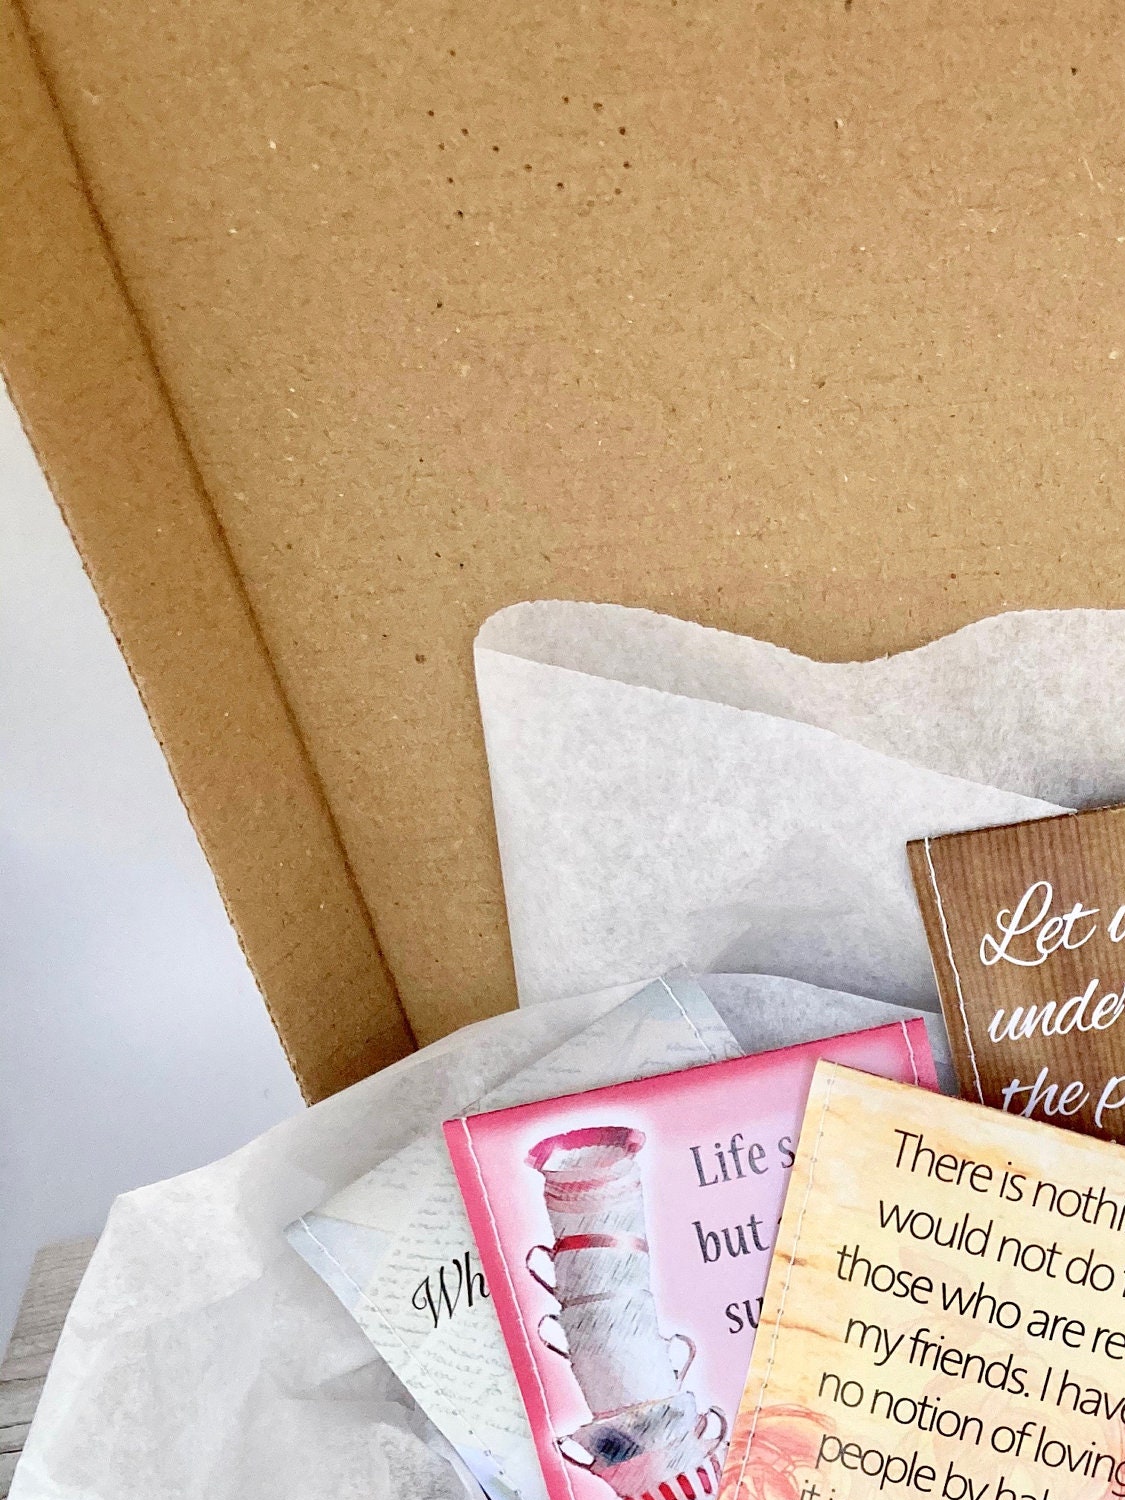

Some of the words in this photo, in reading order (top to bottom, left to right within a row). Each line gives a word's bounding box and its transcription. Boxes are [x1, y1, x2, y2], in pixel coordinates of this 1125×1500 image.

[979, 881, 1099, 967] Let
[1002, 1066, 1087, 1117] the
[690, 1133, 769, 1187] Life
[894, 1129, 994, 1193] There
[1001, 1162, 1025, 1202] is
[692, 1214, 770, 1263] but
[878, 1201, 992, 1257] would
[999, 1234, 1061, 1278] not
[1067, 1249, 1116, 1293] do
[836, 1245, 933, 1305] those
[940, 1281, 1021, 1329] who
[1028, 1309, 1085, 1349] are
[844, 1317, 905, 1365] my
[909, 1328, 1029, 1398] friends.
[1039, 1366, 1050, 1401] I
[819, 1371, 864, 1408] no
[870, 1384, 983, 1446] notion
[991, 1422, 1031, 1455] of
[816, 1433, 937, 1500] people
